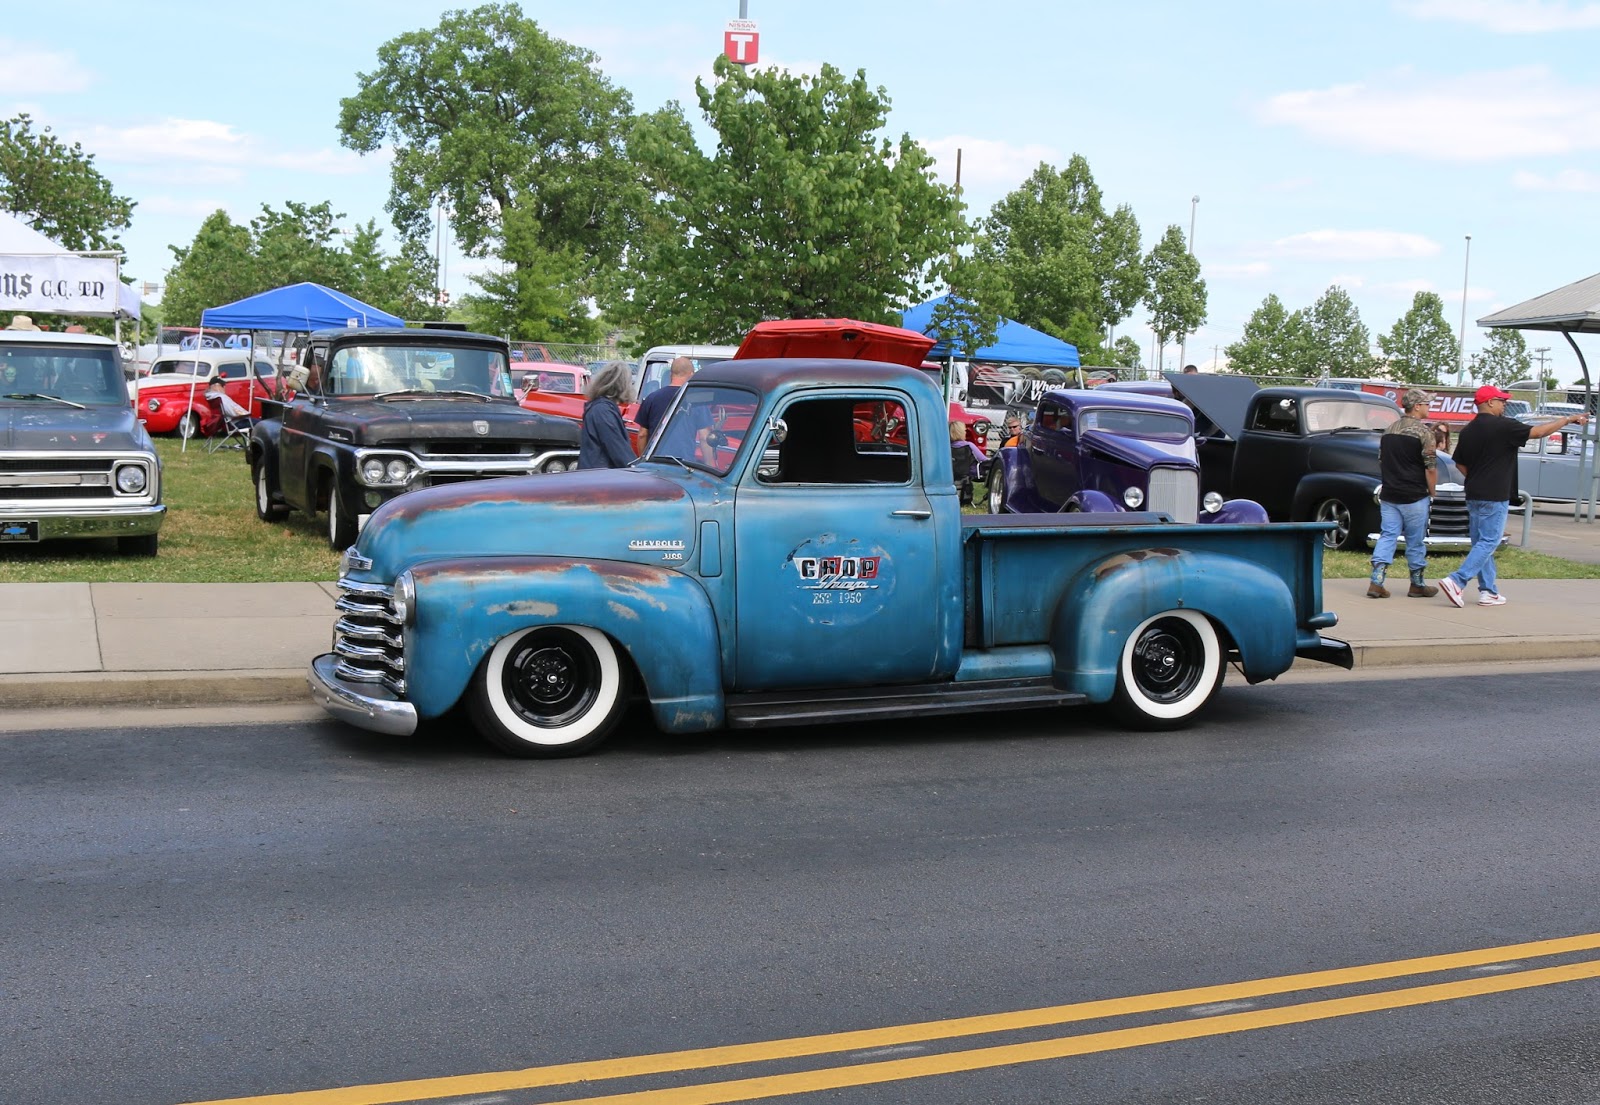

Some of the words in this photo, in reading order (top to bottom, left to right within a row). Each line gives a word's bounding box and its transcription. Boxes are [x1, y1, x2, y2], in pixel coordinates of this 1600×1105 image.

[730, 34, 753, 60] T
[0, 273, 33, 300] ns
[224, 334, 252, 349] 40
[1031, 380, 1066, 392] Wheel
[630, 540, 684, 548] CHEVROLET
[663, 552, 683, 560] 3100
[800, 558, 876, 578] CHOP
[839, 592, 862, 604] 1950
